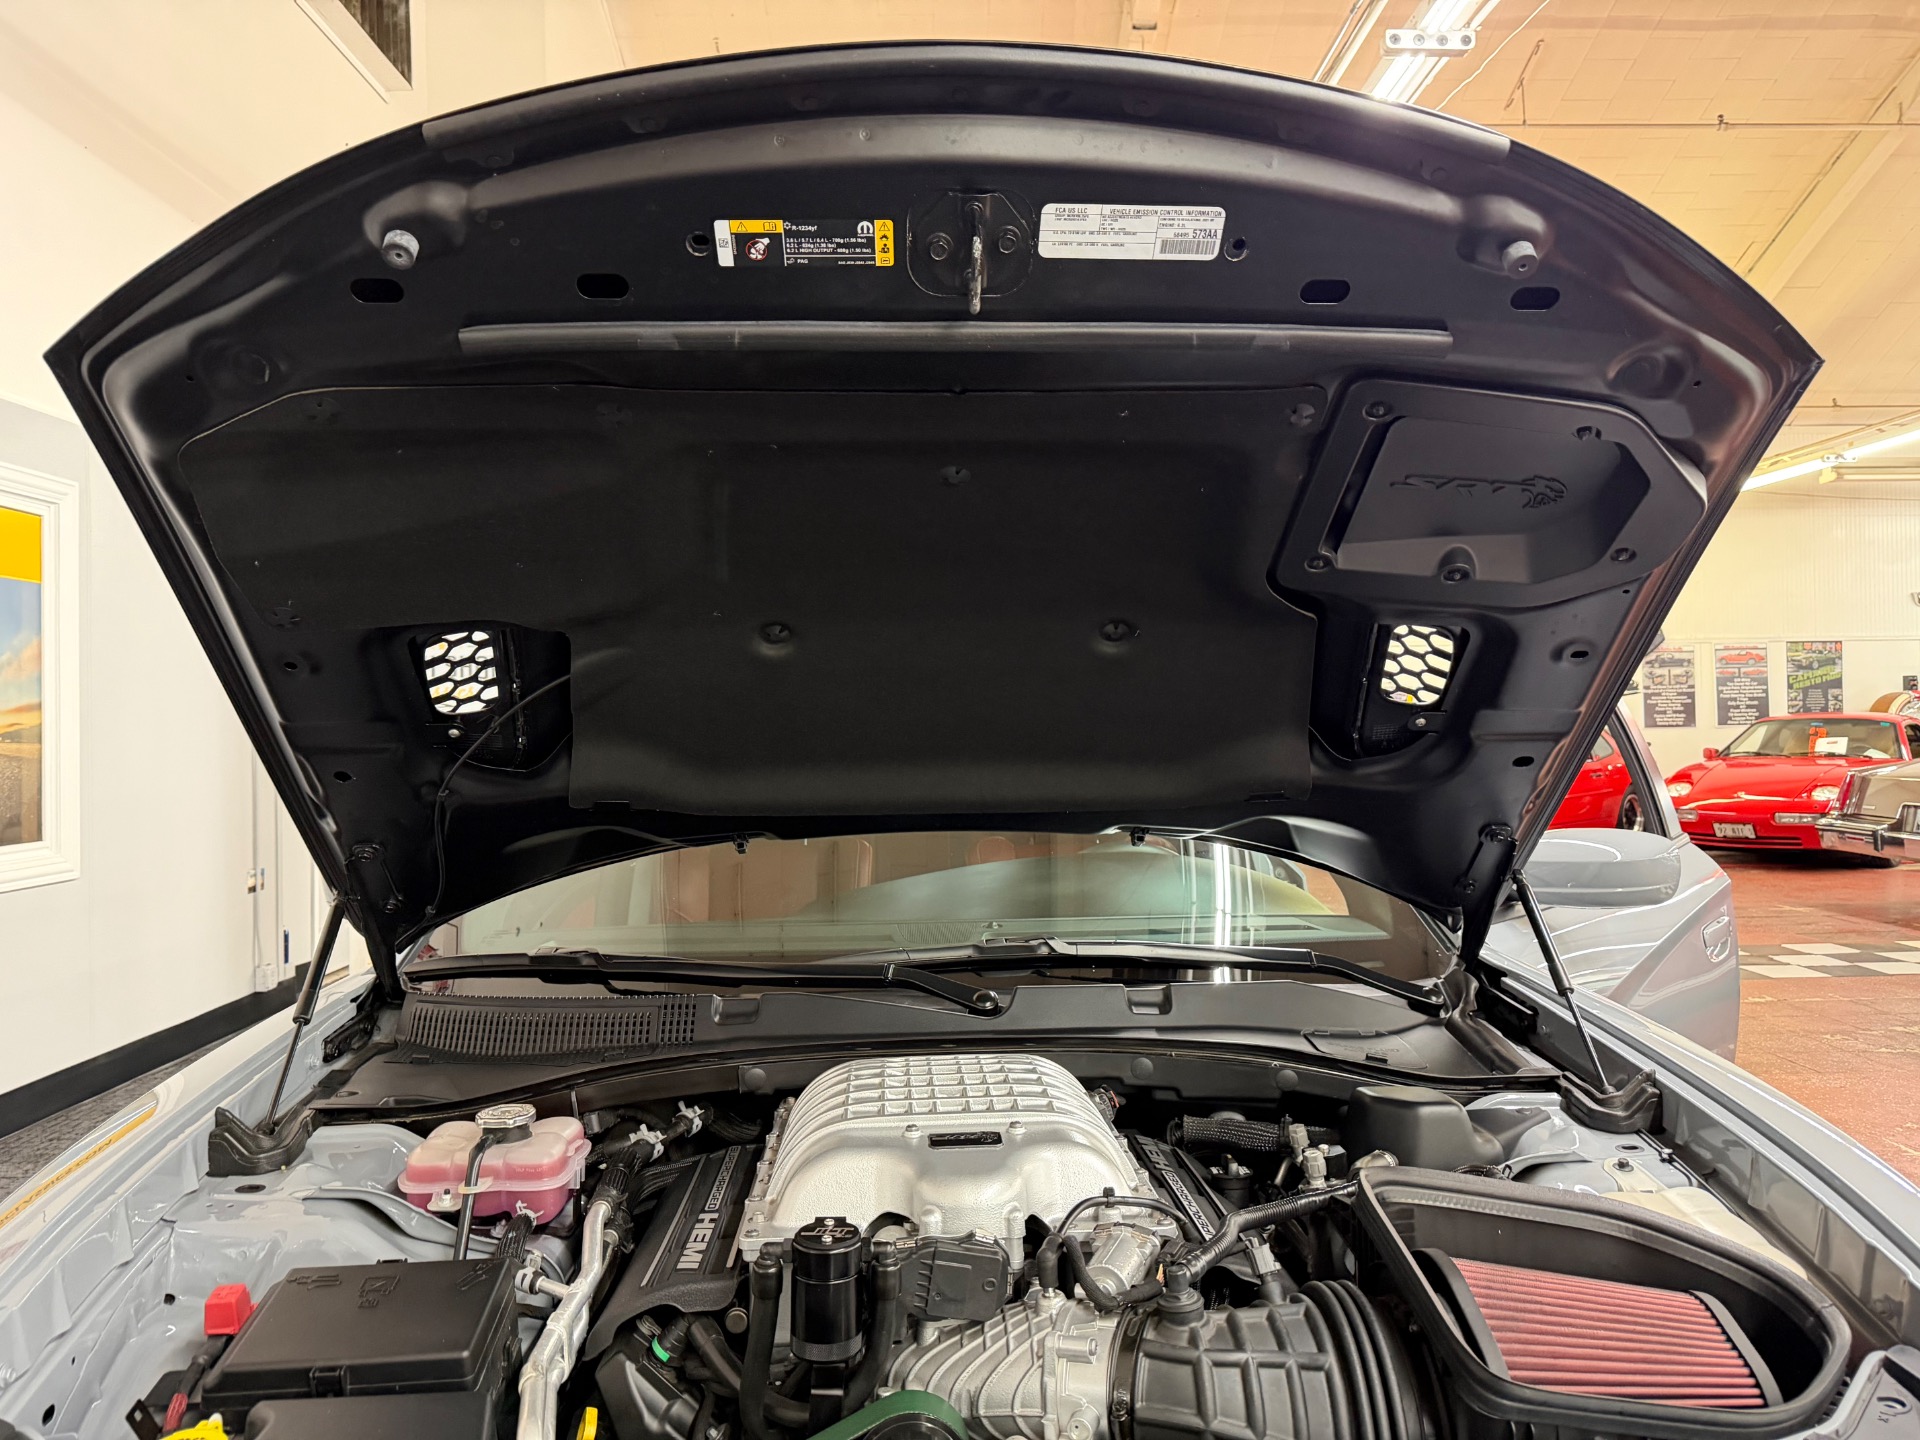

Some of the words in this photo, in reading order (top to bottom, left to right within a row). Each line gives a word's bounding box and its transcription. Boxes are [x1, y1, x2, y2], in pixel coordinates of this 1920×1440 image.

[1192, 229, 1218, 239] 573AA
[707, 1146, 740, 1211] SUPERCHARGED
[676, 1213, 719, 1270] HEMI
